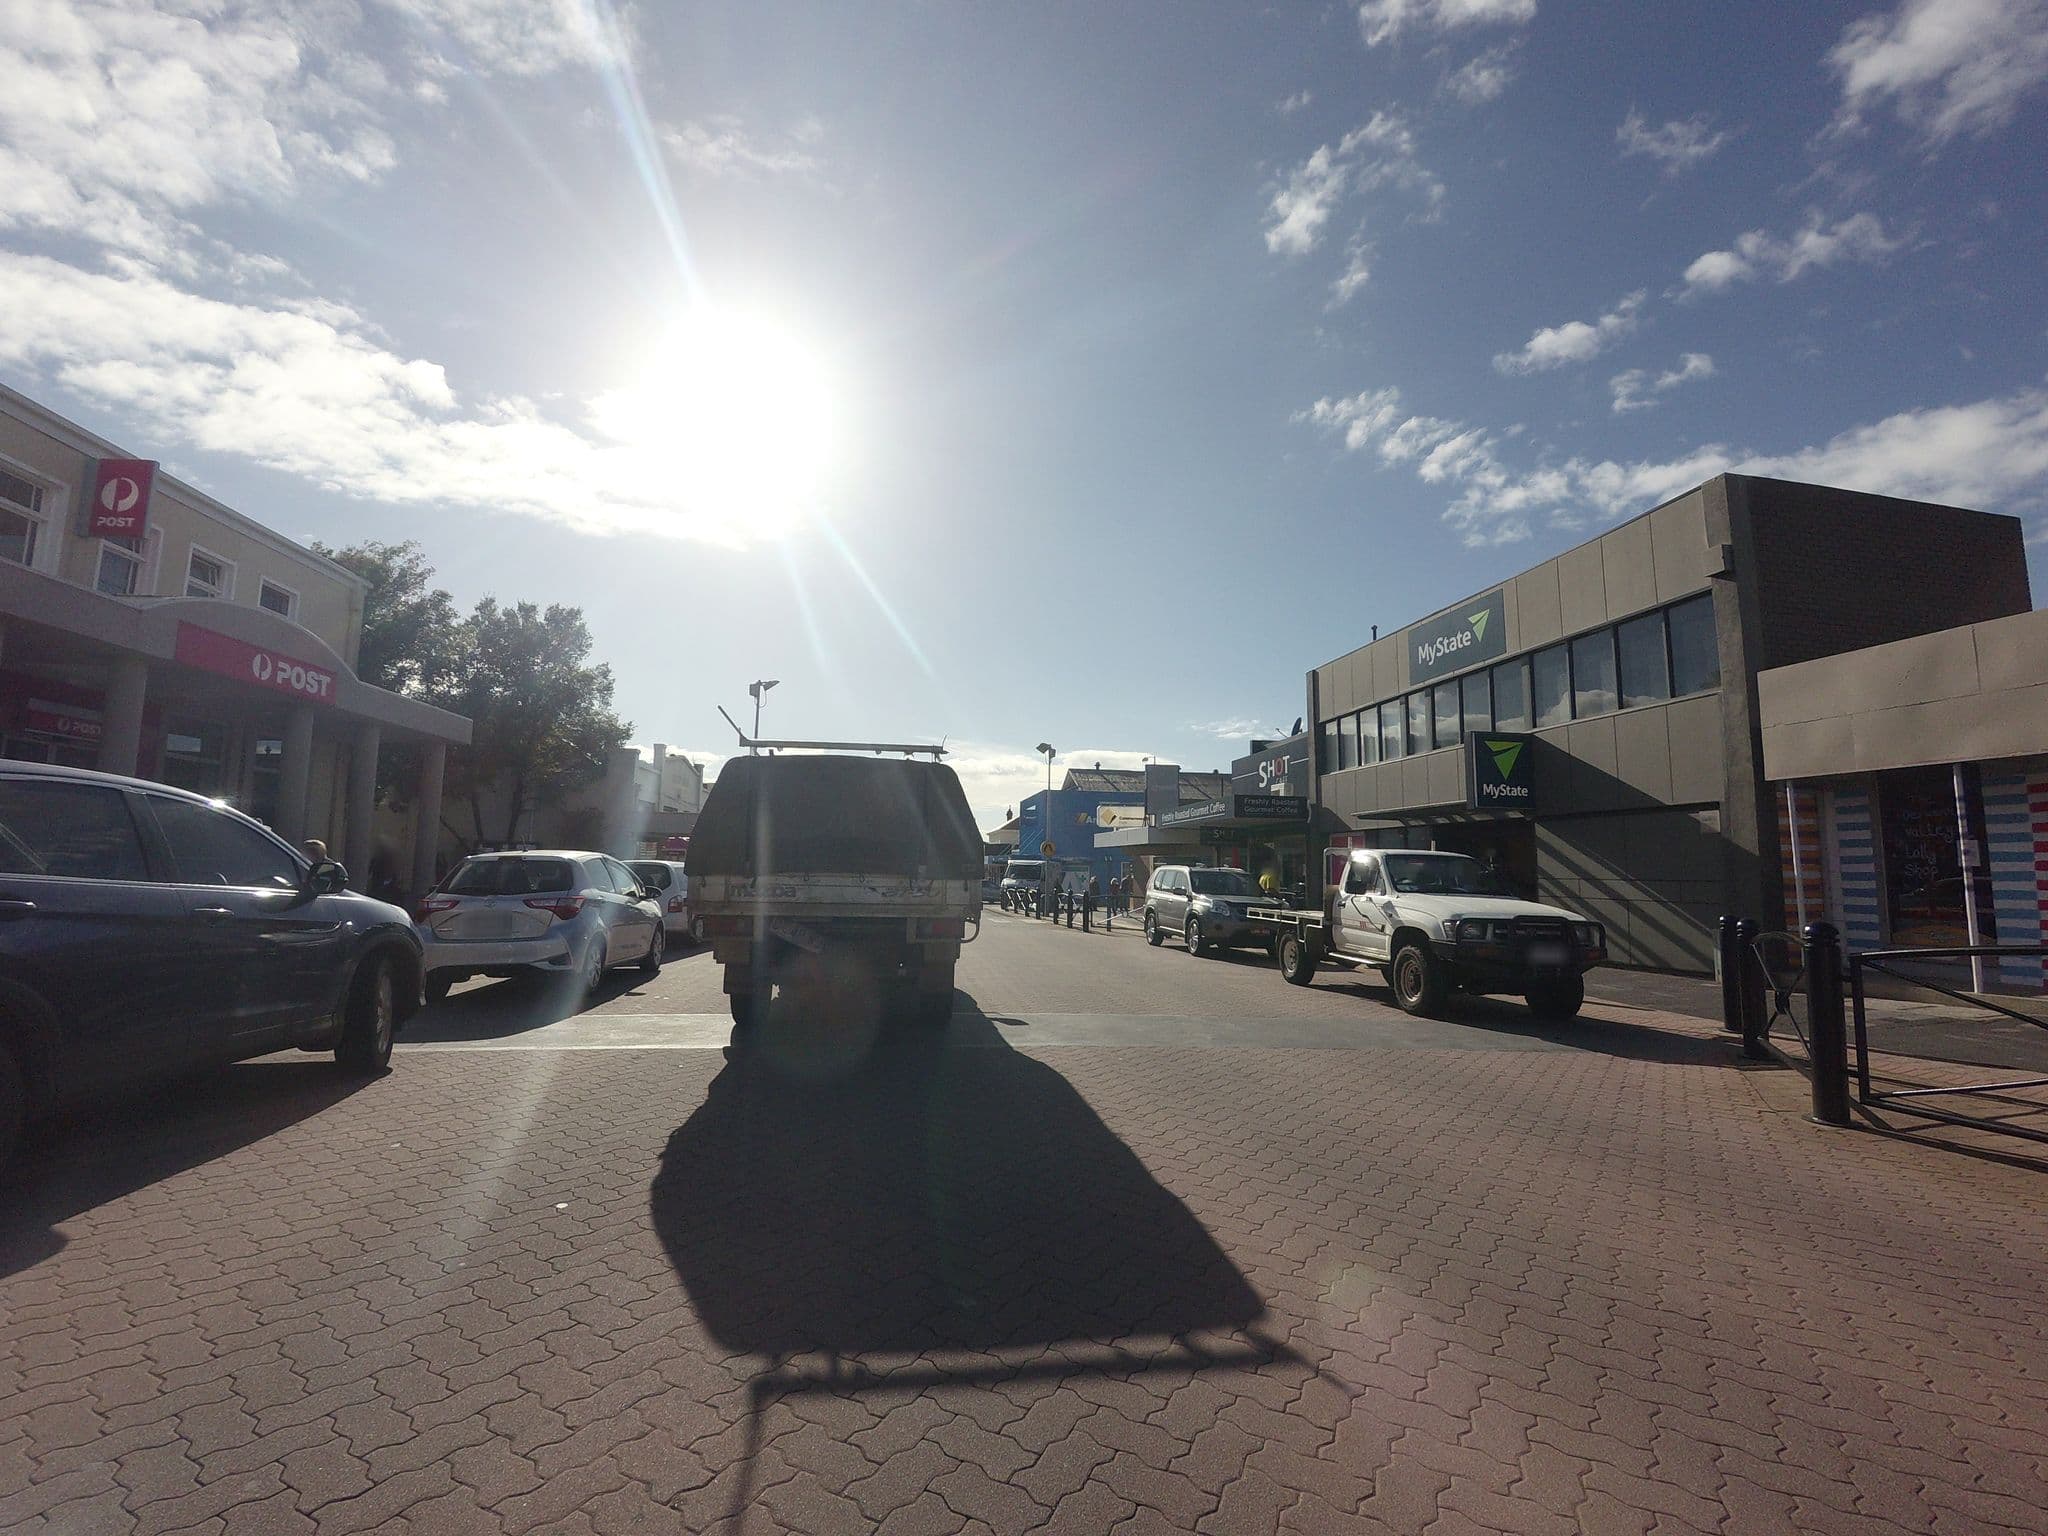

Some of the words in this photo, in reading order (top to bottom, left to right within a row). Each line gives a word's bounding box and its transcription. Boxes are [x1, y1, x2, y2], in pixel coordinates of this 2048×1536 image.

[97, 516, 136, 529] POST
[1417, 627, 1472, 666] MyState
[275, 662, 332, 697] POST
[71, 721, 102, 736] POST
[1258, 755, 1290, 788] SHOT
[1483, 783, 1529, 799] MyState
[1209, 801, 1226, 814] Coffee
